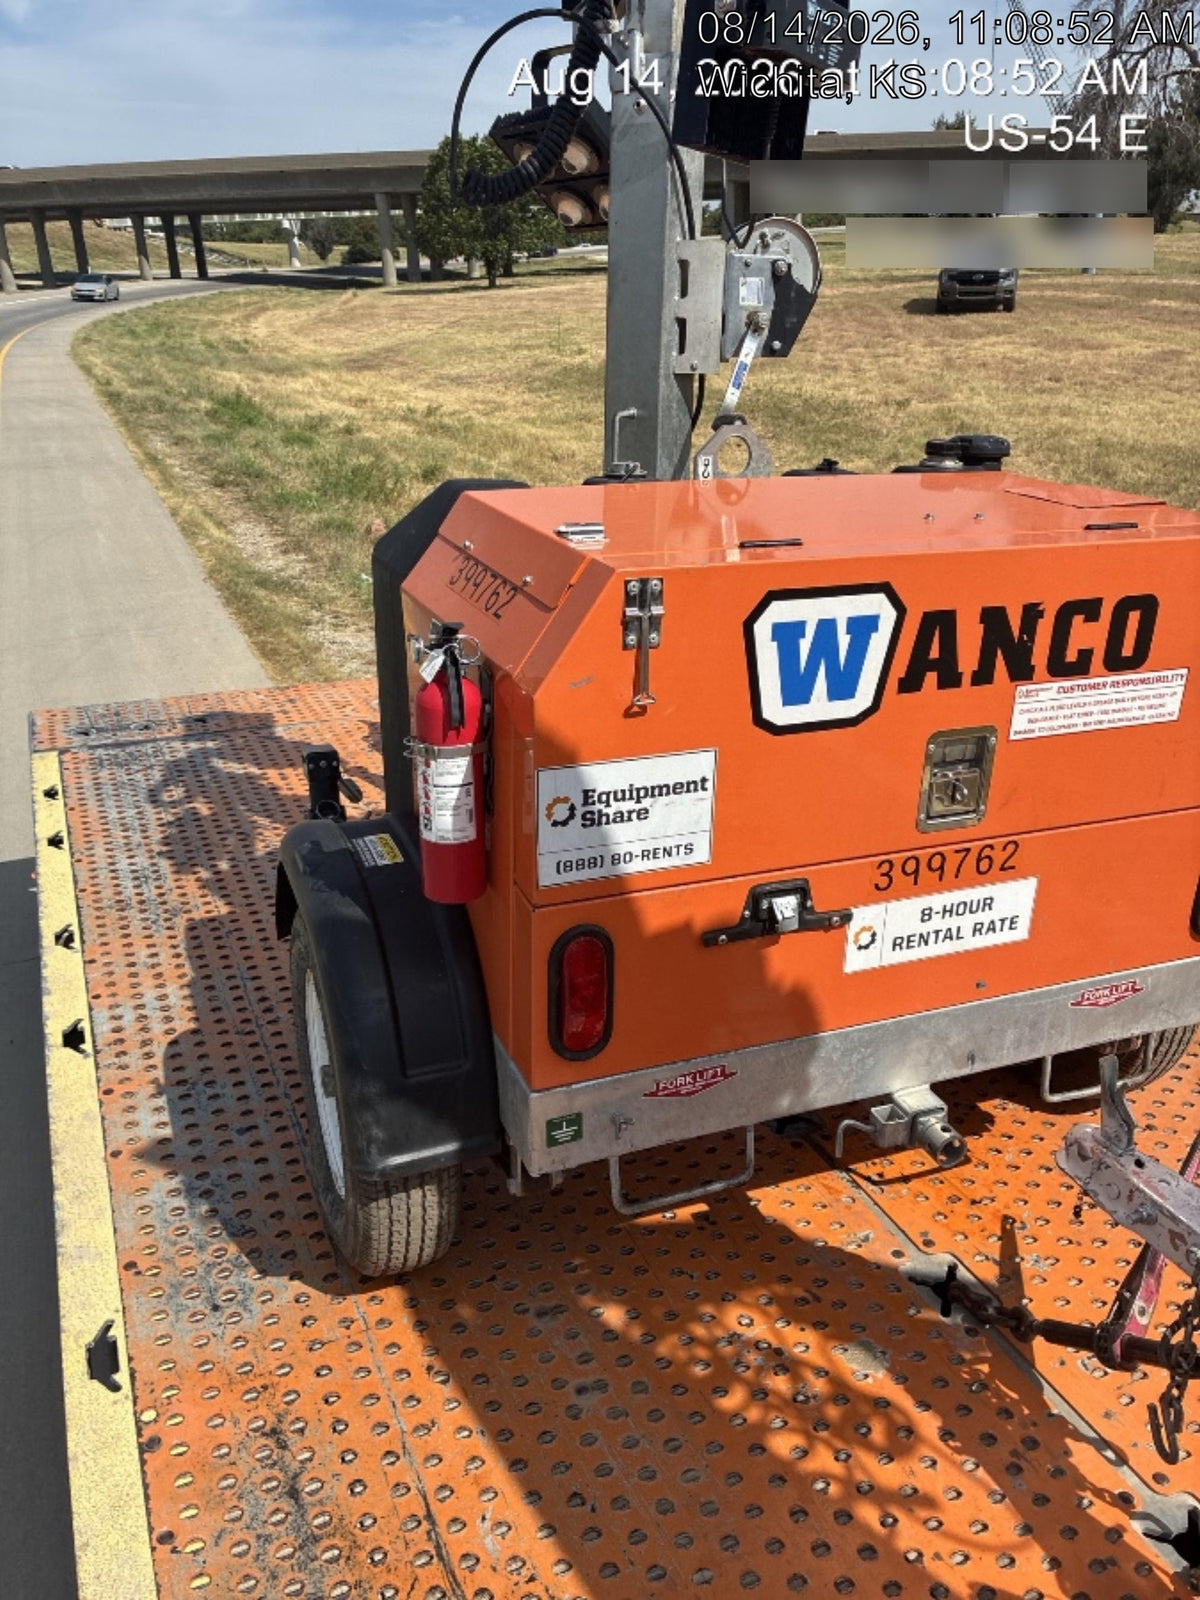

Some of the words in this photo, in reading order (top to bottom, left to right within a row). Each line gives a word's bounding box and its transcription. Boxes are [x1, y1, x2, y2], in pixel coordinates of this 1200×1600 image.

[449, 556, 518, 620] 399762
[771, 592, 1159, 707] WANCO
[1056, 681, 1109, 695] CUSTOMER
[1109, 673, 1185, 690] RESPONSIBILITY
[581, 775, 709, 808] Equipment
[580, 806, 650, 829] Share
[556, 854, 604, 875] (888)
[611, 842, 695, 867] 80-RENTS
[873, 839, 1020, 892] 399762
[920, 896, 995, 923] 8-HOUR
[892, 925, 965, 952] RENTAL
[972, 914, 1020, 938] RATE
